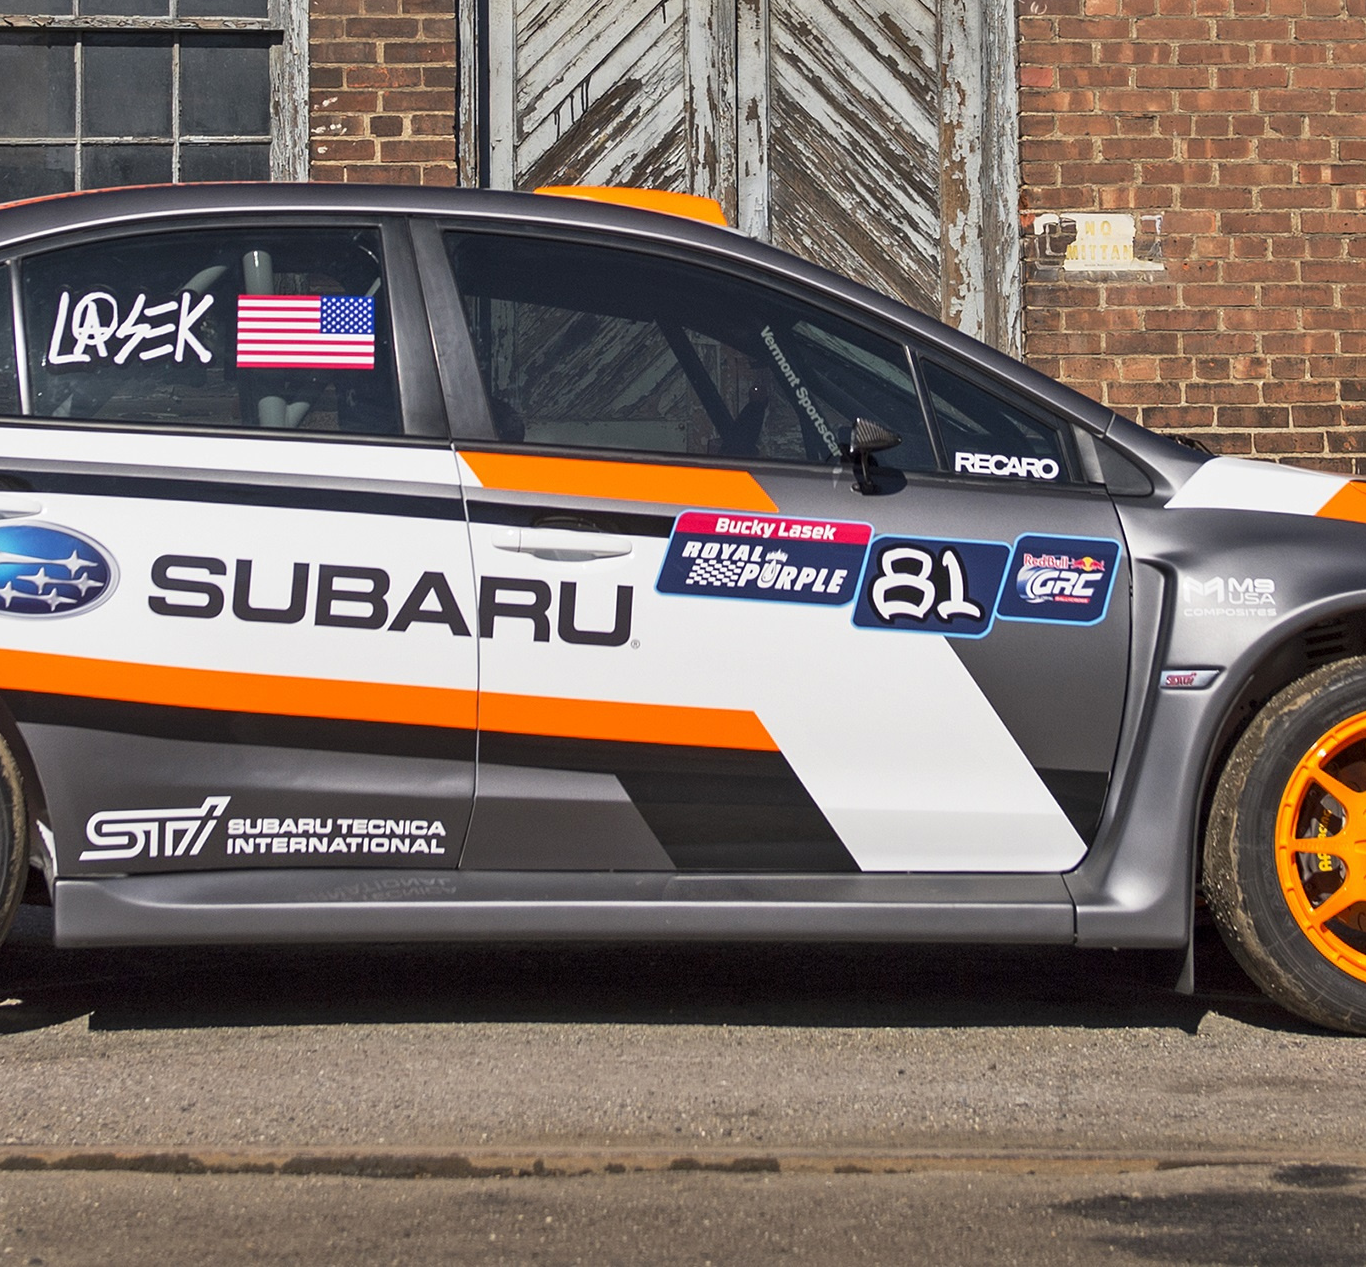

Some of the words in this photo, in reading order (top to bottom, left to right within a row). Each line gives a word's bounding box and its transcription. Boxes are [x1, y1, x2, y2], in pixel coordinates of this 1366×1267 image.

[1085, 220, 1112, 236] NO
[48, 291, 214, 364] LASEK
[760, 325, 801, 388] Vermont
[796, 386, 843, 458] SportsCar
[955, 451, 1060, 480] RECARO
[715, 517, 776, 539] Bucky
[778, 521, 837, 541] Lasek
[681, 540, 764, 563] ROYAL
[737, 562, 848, 594] PURPLE
[872, 547, 982, 620] 81
[1031, 569, 1104, 597] GRC
[1227, 577, 1276, 593] M9
[147, 554, 634, 648] SUBARU
[1228, 592, 1276, 605] USA
[1183, 608, 1277, 617] COMPOSITES
[227, 818, 334, 835] SUBARU
[336, 819, 447, 836] TECNICA
[226, 837, 446, 854] INTERNATIONAL
